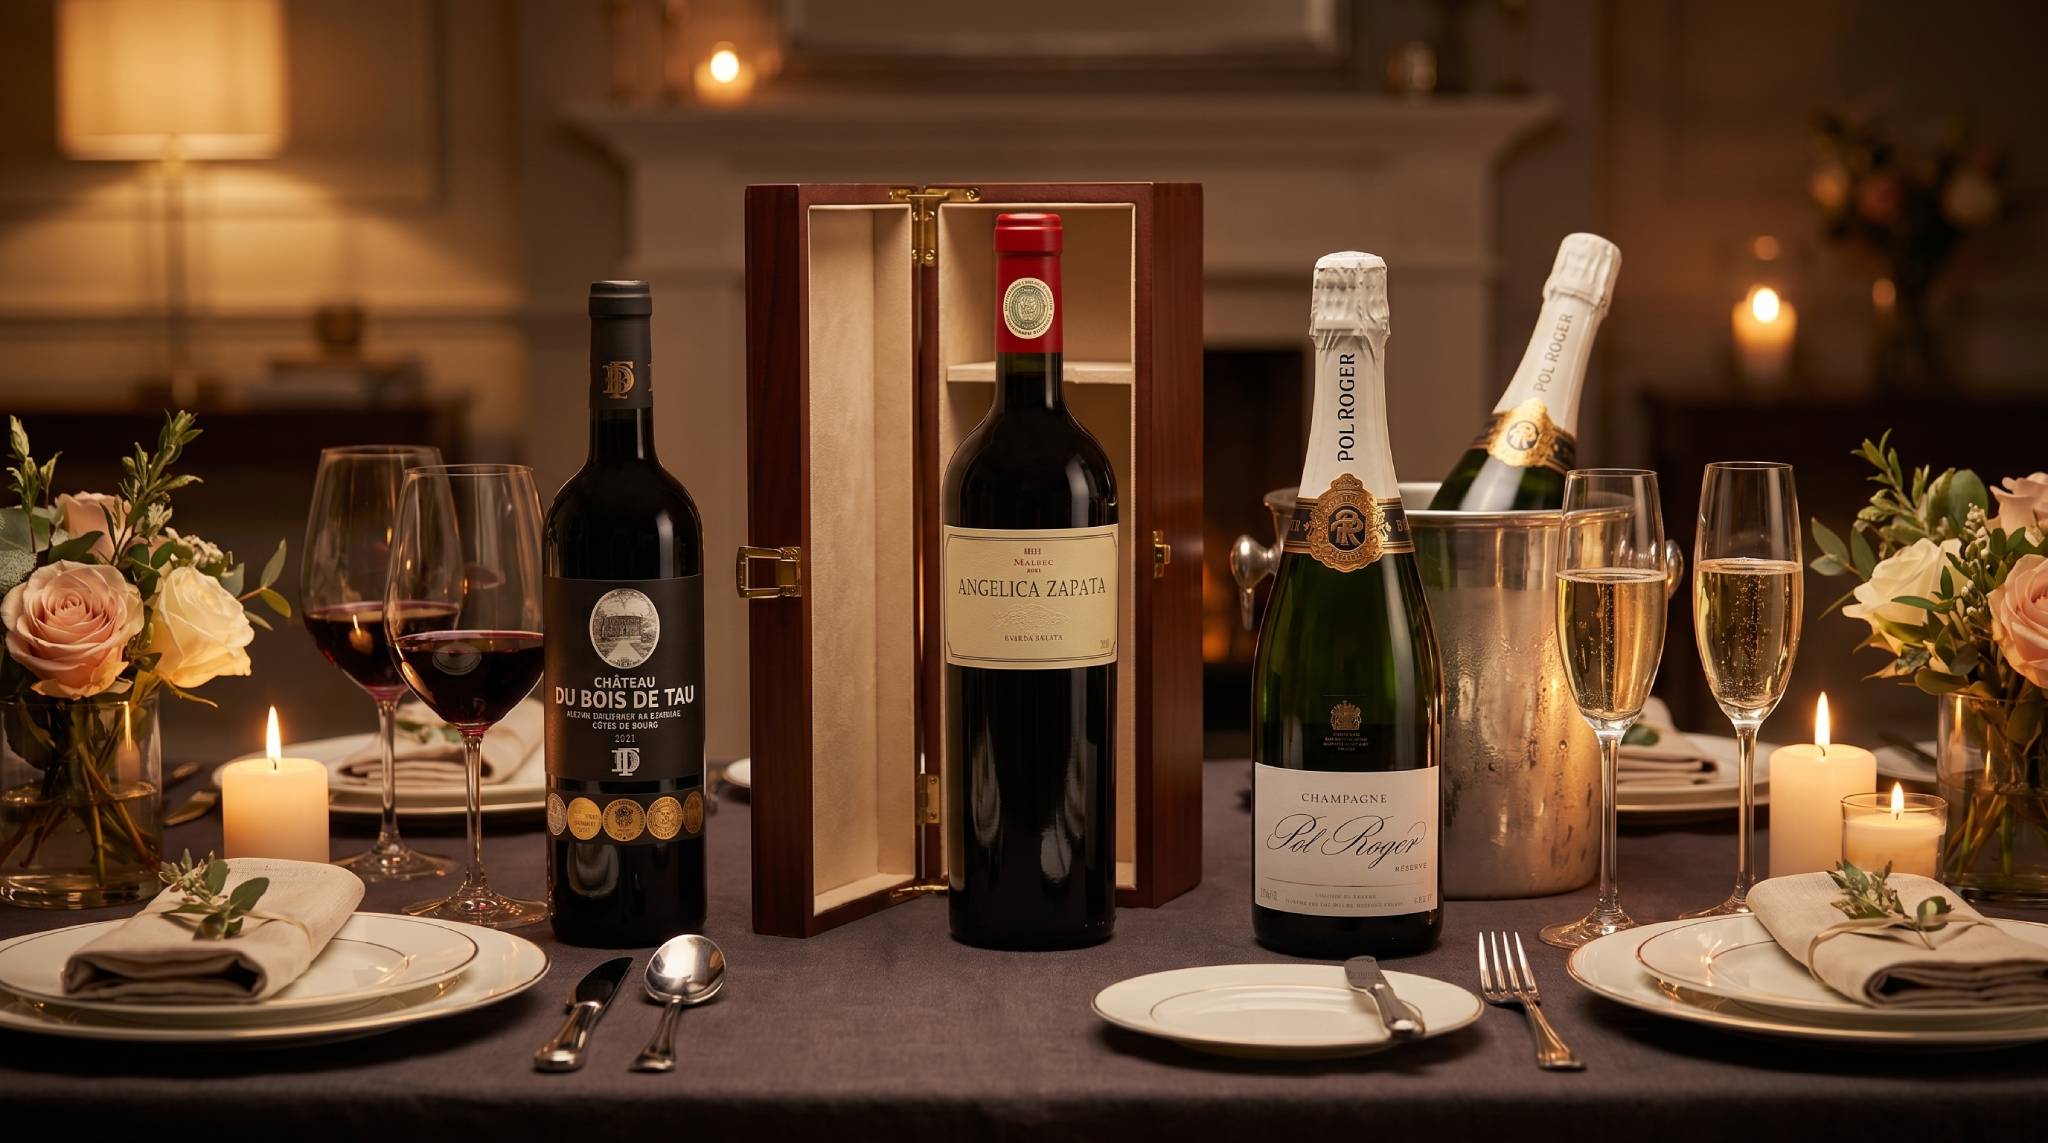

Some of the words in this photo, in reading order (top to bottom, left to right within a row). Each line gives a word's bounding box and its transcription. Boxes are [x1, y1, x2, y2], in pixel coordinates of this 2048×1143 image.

[1533, 366, 1555, 392] POL
[1544, 313, 1573, 364] ROGER
[1337, 352, 1355, 421] ROGER
[1337, 423, 1355, 462] POL
[1013, 558, 1054, 567] MALBEC
[958, 578, 1040, 598] ANGELICA
[1046, 577, 1106, 598] ZAPATA
[594, 674, 656, 689] CHÂTEAU
[555, 686, 576, 706] DU
[580, 690, 627, 709] BOIS
[633, 689, 660, 709] DE
[664, 685, 694, 707] TAU
[619, 722, 630, 730] DE
[614, 734, 636, 743] 2021
[1301, 792, 1387, 804] CHAMPAGNE
[1266, 813, 1328, 853] Pol
[1320, 815, 1427, 869] Roger
